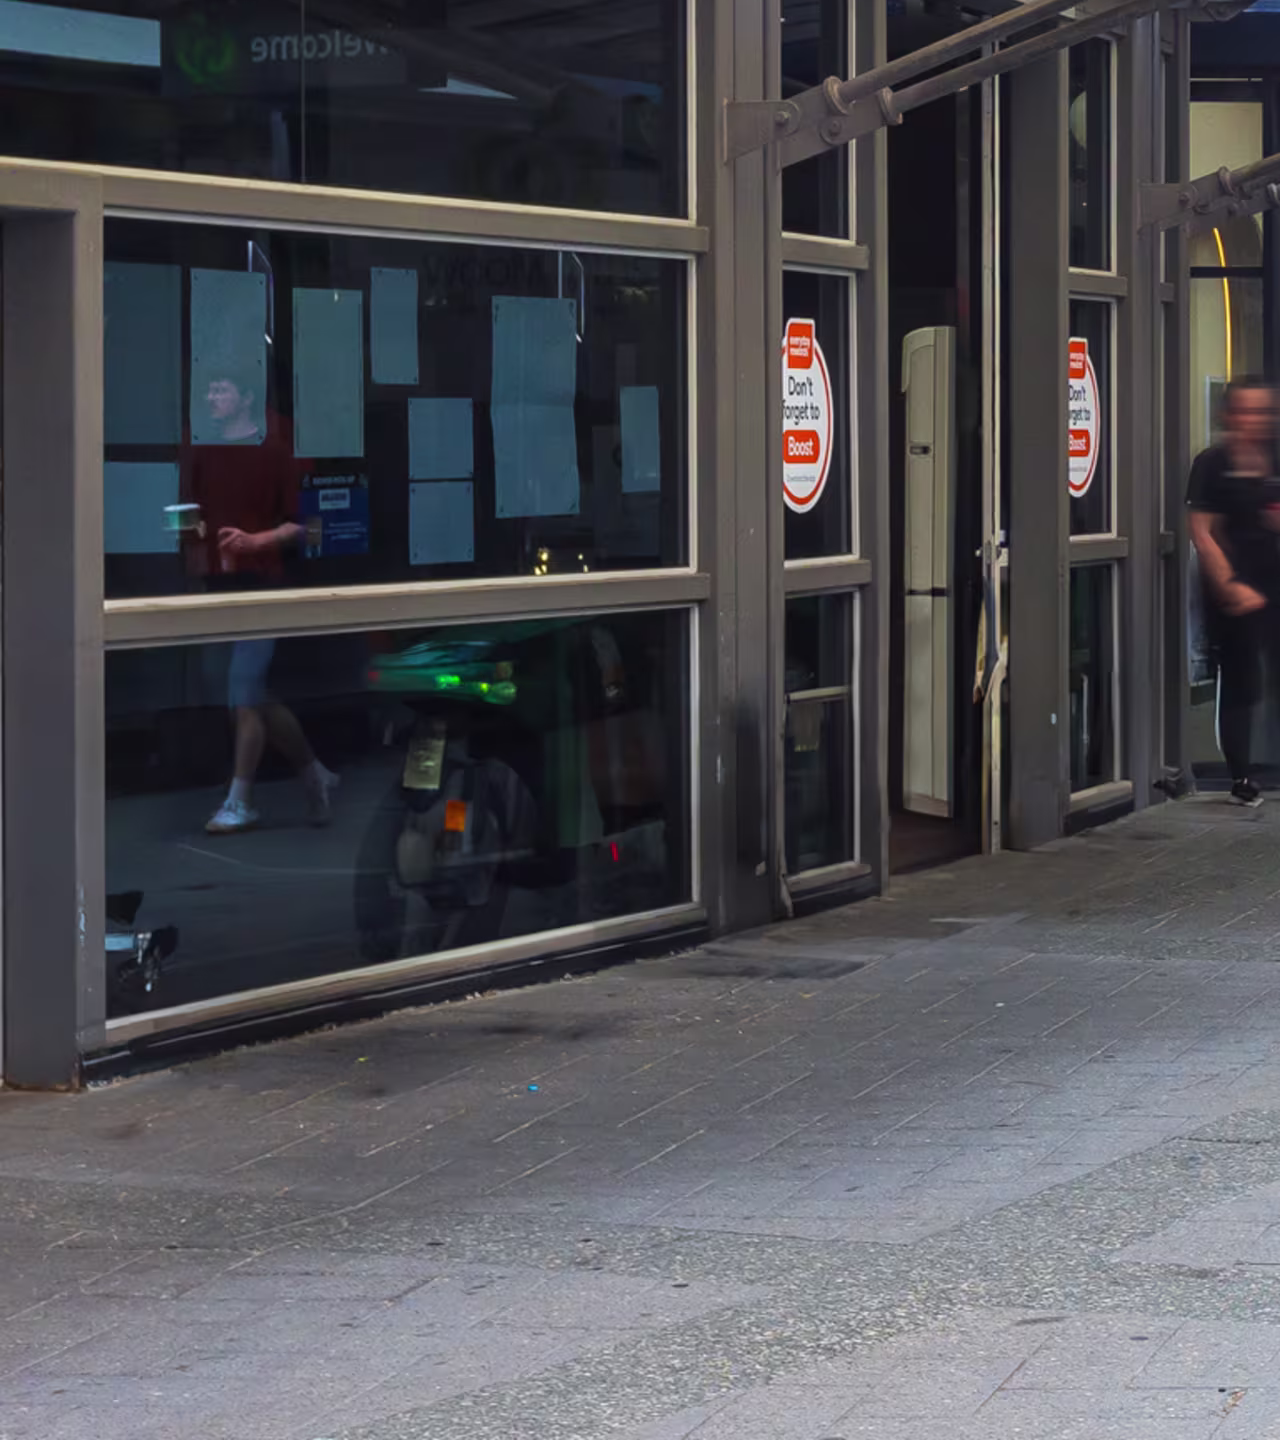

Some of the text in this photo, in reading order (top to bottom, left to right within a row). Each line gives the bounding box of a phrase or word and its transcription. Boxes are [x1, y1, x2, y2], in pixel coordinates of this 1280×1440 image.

[788, 376, 813, 396] Don't
[810, 400, 820, 421] to
[788, 436, 814, 457] Boost
